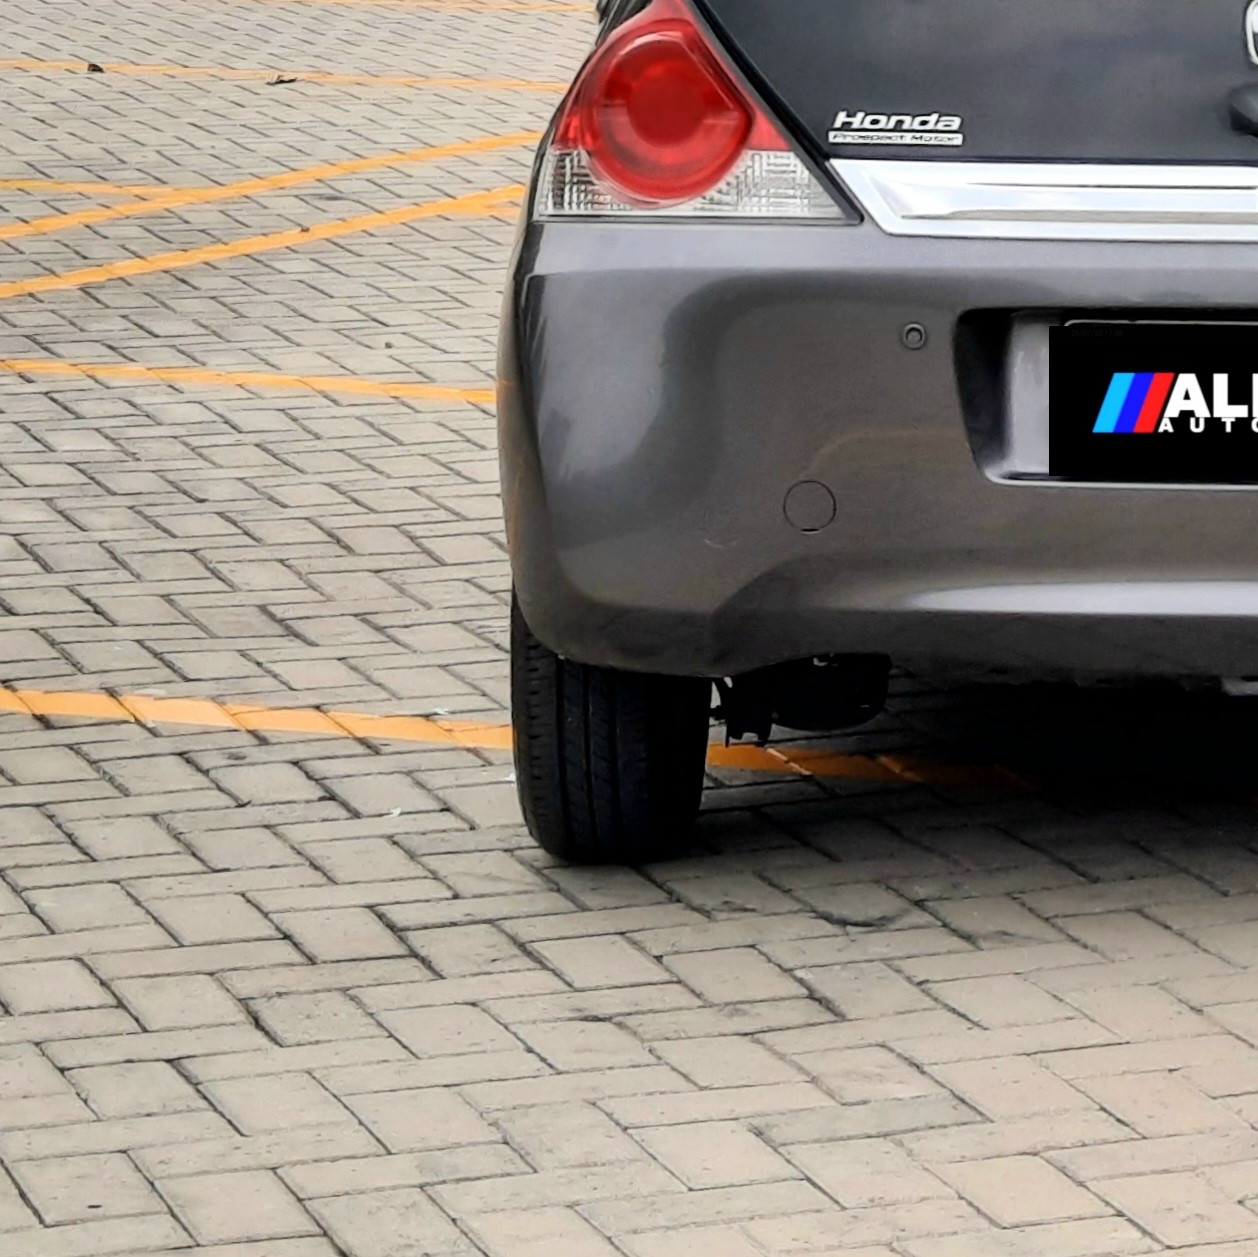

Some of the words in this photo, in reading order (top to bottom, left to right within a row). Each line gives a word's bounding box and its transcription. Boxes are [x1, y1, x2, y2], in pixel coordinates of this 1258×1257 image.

[833, 110, 962, 132] Honda
[832, 133, 907, 142] Prospect
[910, 133, 960, 142] Motor
